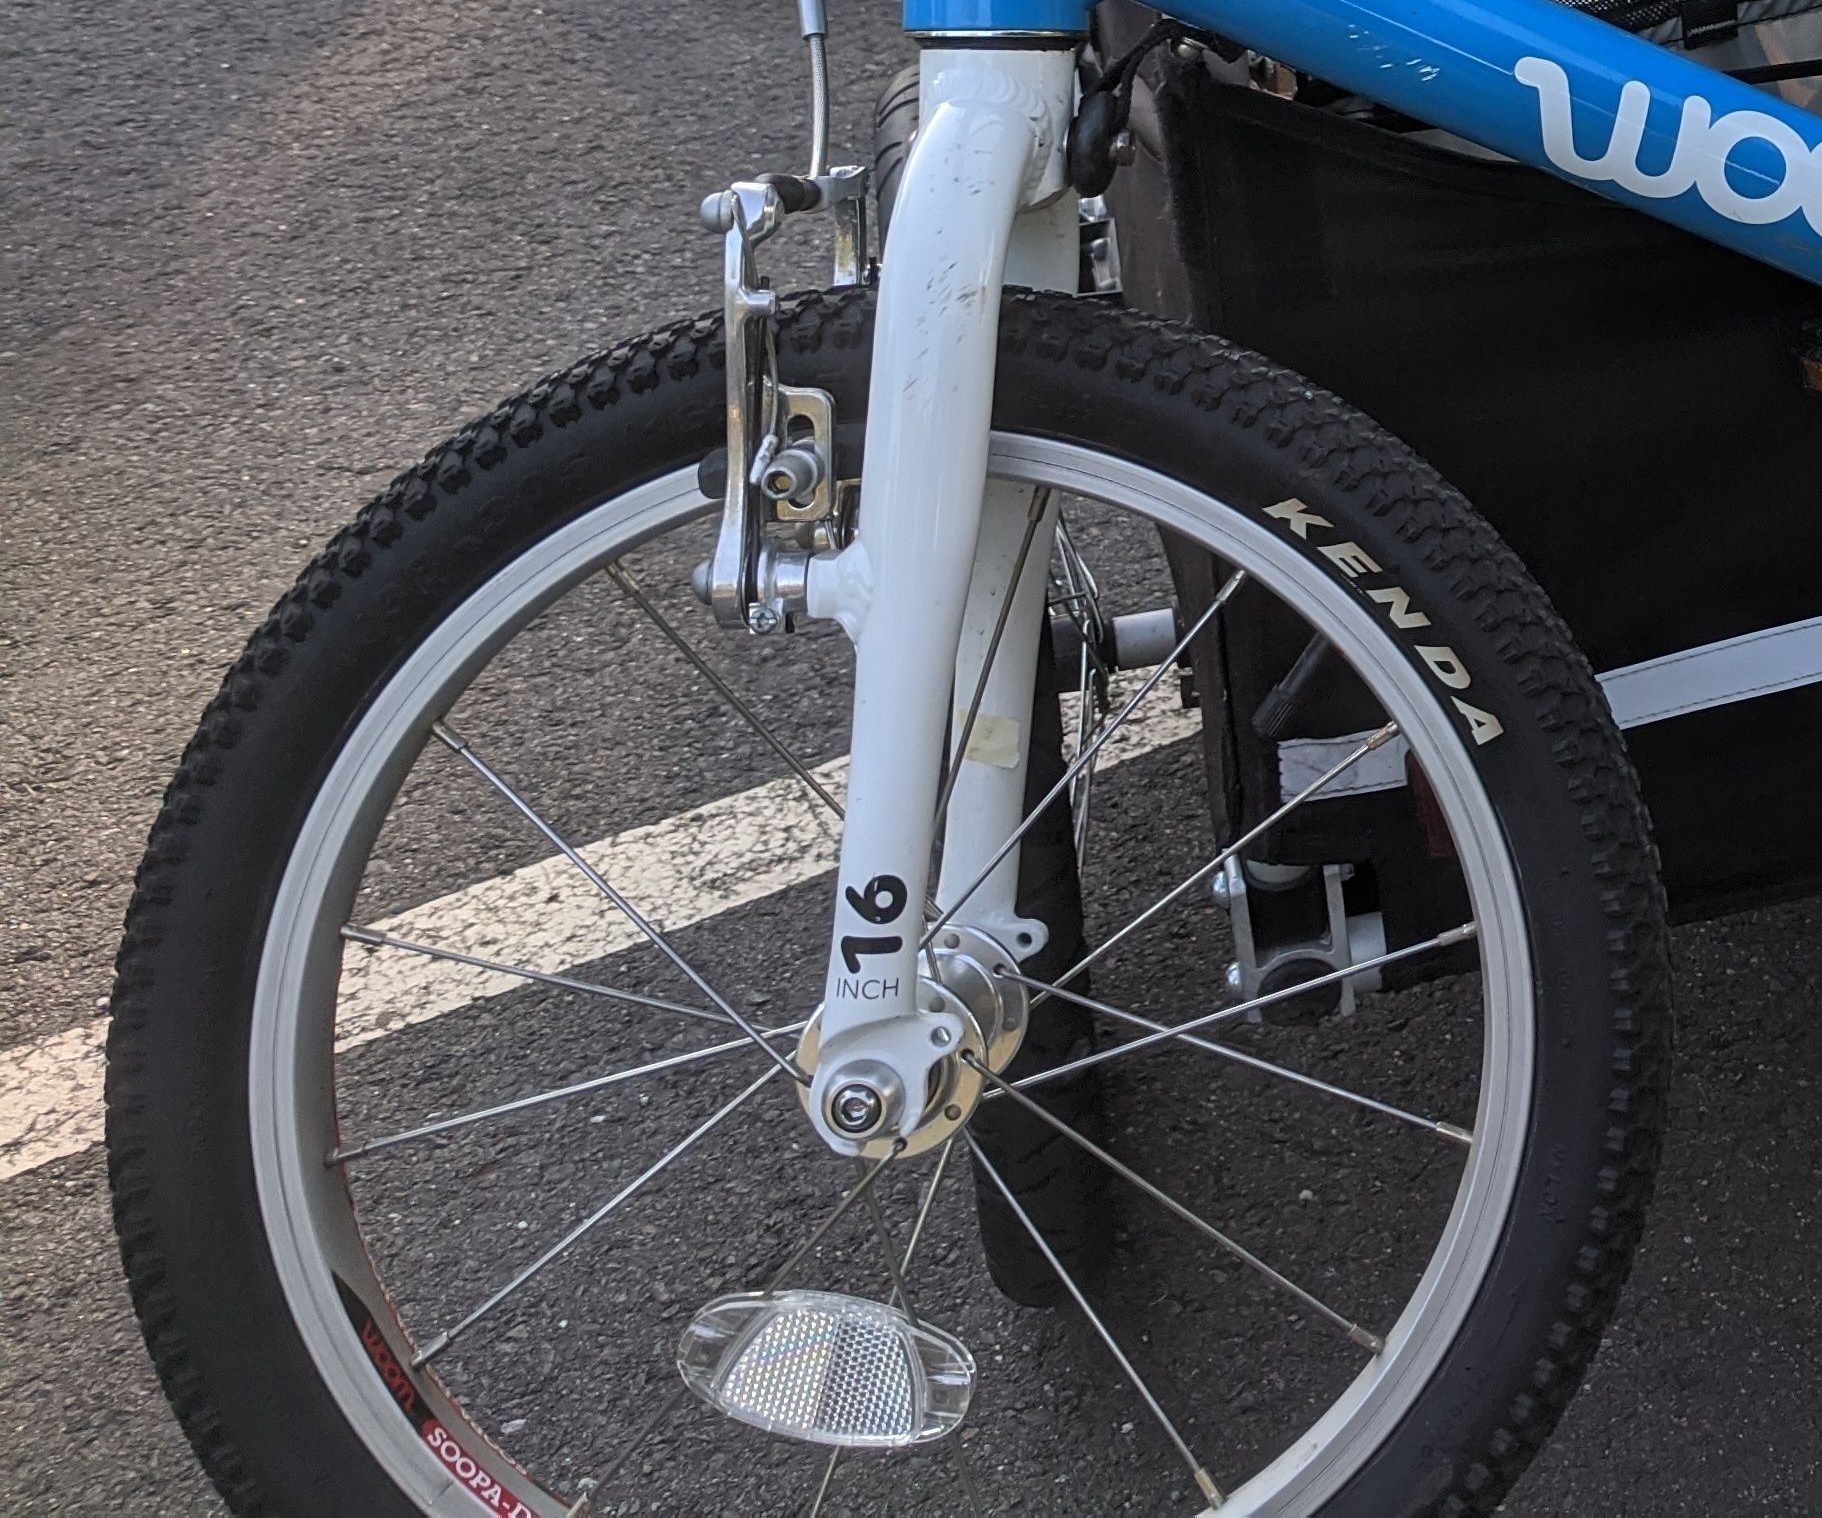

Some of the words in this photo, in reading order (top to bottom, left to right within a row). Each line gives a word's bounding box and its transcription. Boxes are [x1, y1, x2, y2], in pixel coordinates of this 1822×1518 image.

[1261, 497, 1504, 746] KENDA
[840, 874, 908, 974] 16
[836, 977, 900, 1000] INCH
